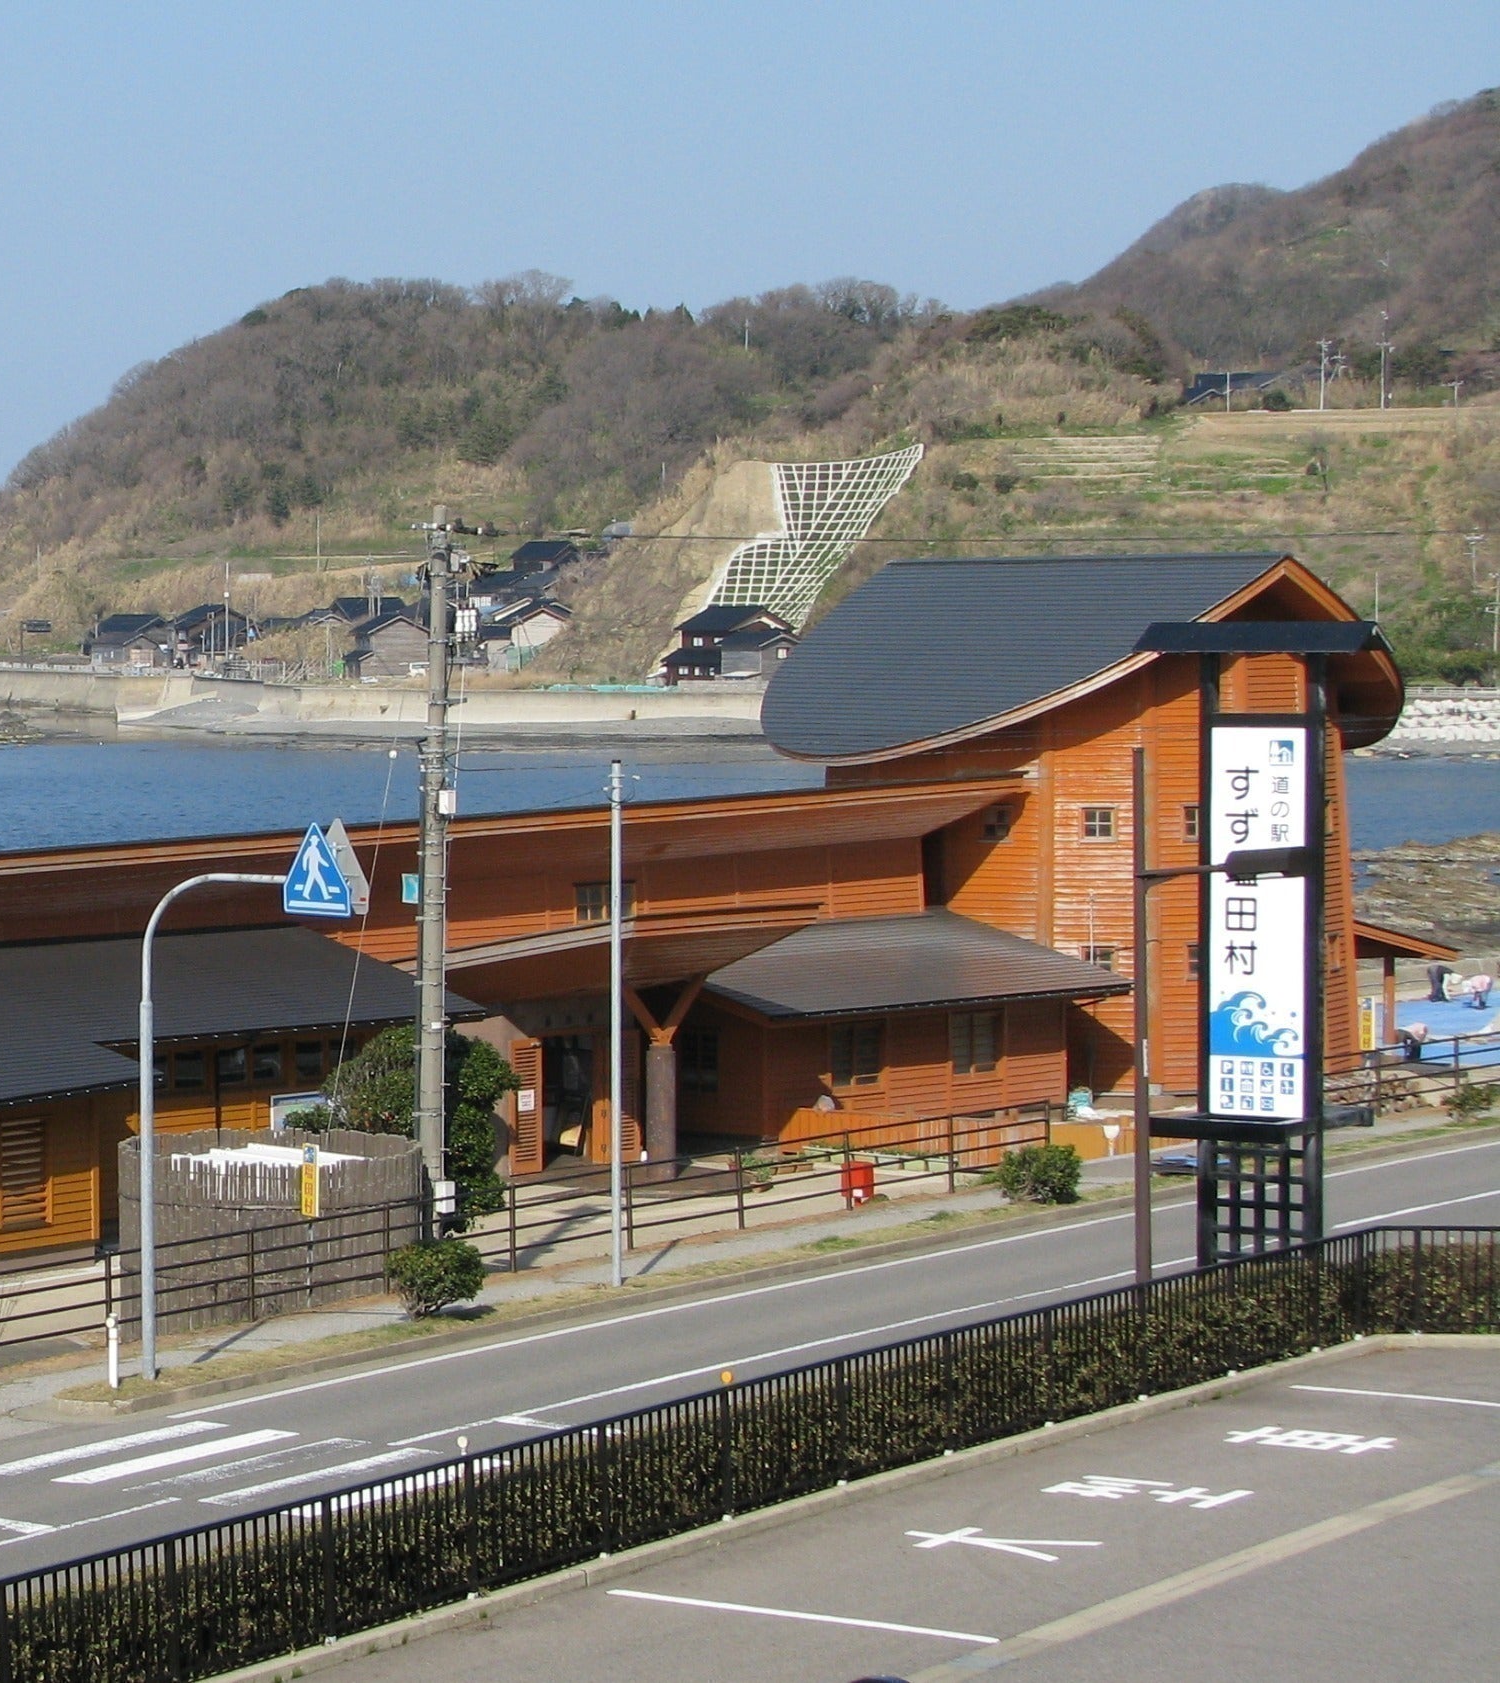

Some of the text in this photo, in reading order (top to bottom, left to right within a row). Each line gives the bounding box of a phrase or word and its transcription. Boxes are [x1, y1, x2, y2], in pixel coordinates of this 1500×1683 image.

[1224, 766, 1259, 976] すず田村
[1269, 774, 1291, 843] 道の駅
